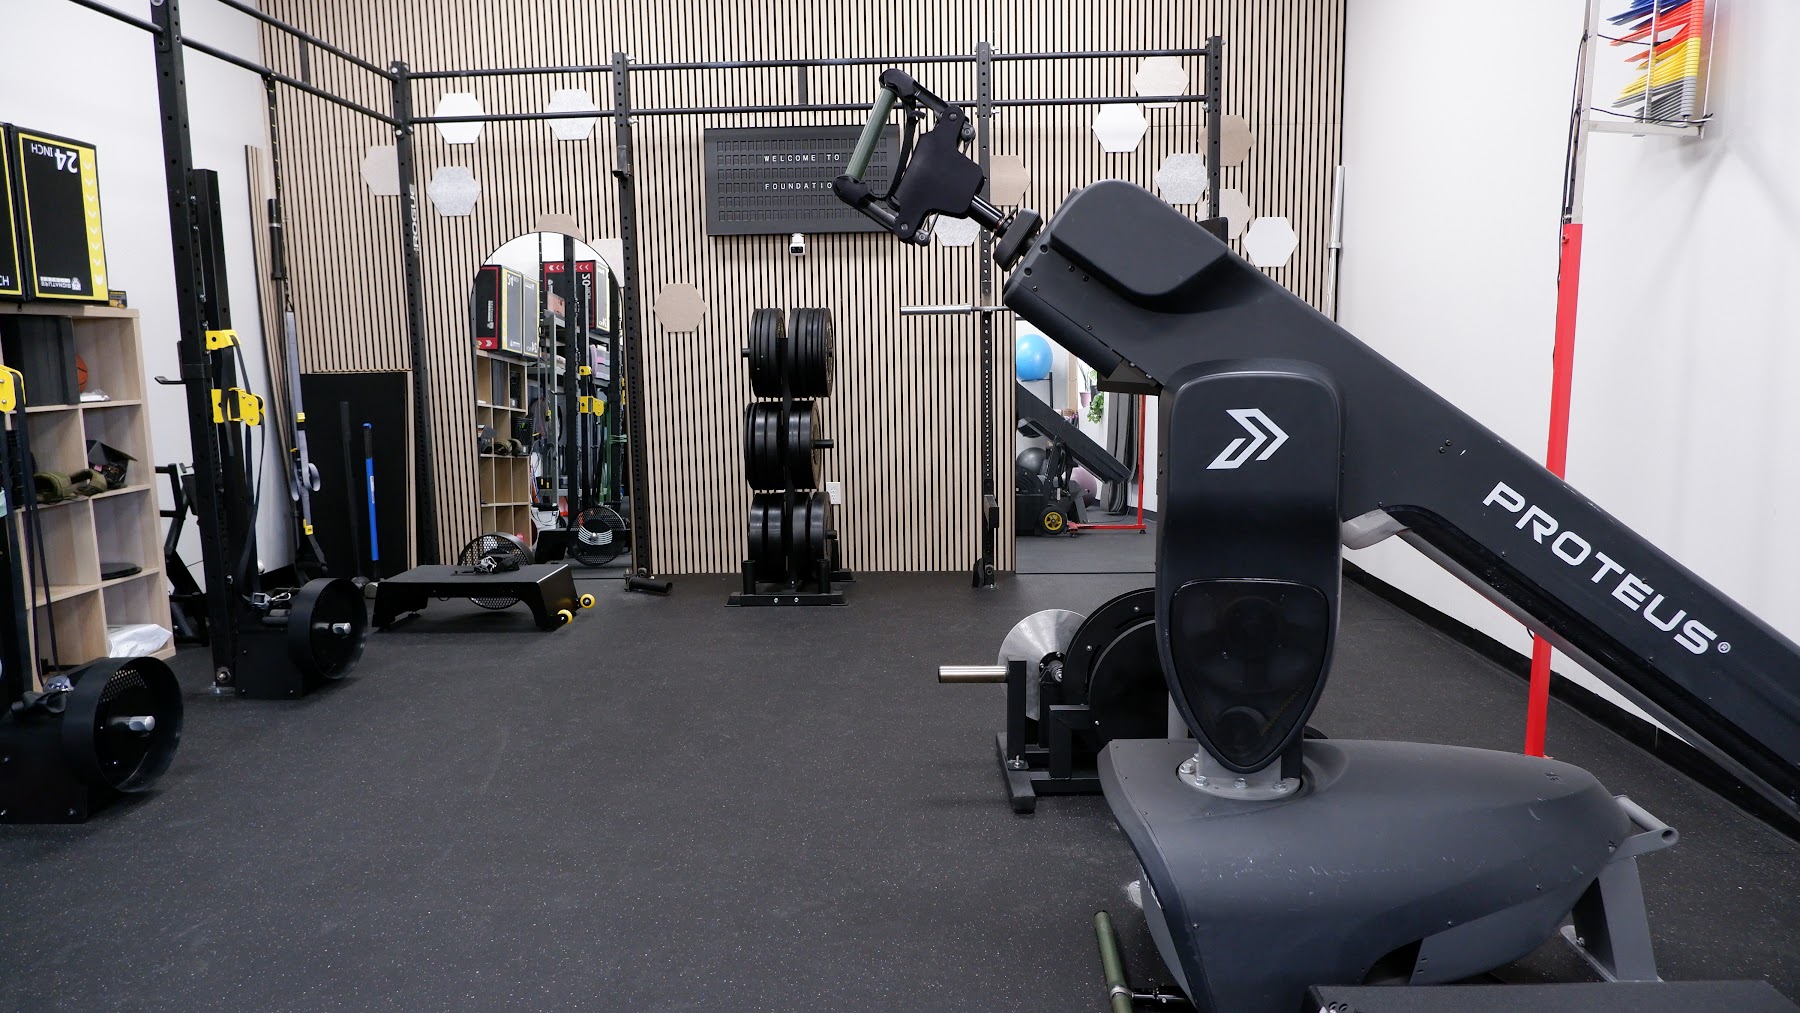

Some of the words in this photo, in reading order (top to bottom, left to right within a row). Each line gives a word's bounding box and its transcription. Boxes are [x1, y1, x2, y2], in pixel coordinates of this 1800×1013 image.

[31, 143, 54, 157] INCH
[55, 148, 78, 173] 24
[764, 154, 816, 162] WELCOME
